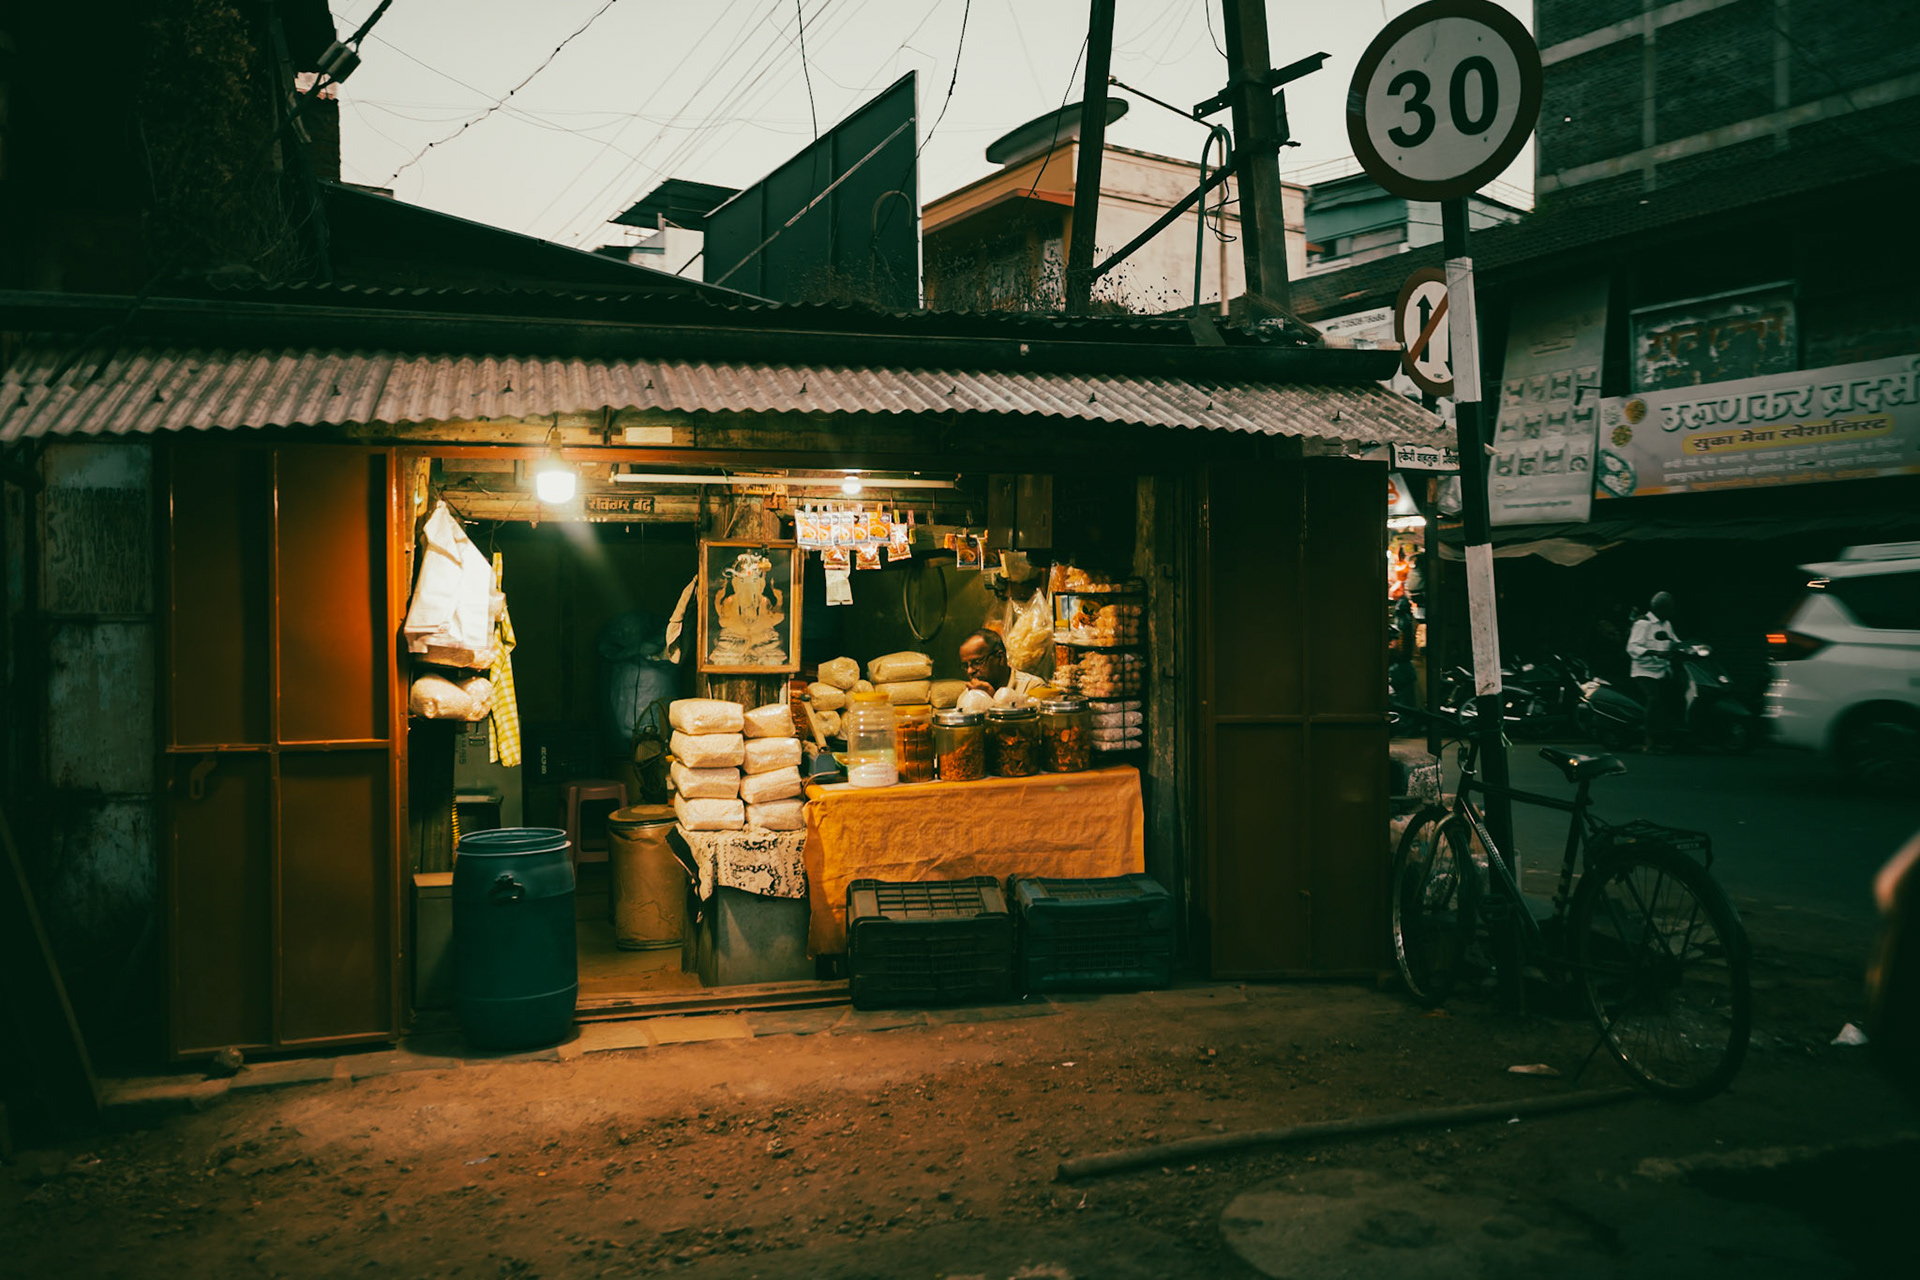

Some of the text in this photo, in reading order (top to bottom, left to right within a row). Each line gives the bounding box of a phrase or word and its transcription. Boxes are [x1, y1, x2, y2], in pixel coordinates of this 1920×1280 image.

[1387, 55, 1499, 148] 30
[1692, 435, 1735, 453] सुका
[1739, 429, 1775, 443] मेवा
[1780, 418, 1888, 438] स्पेशालिस्ट
